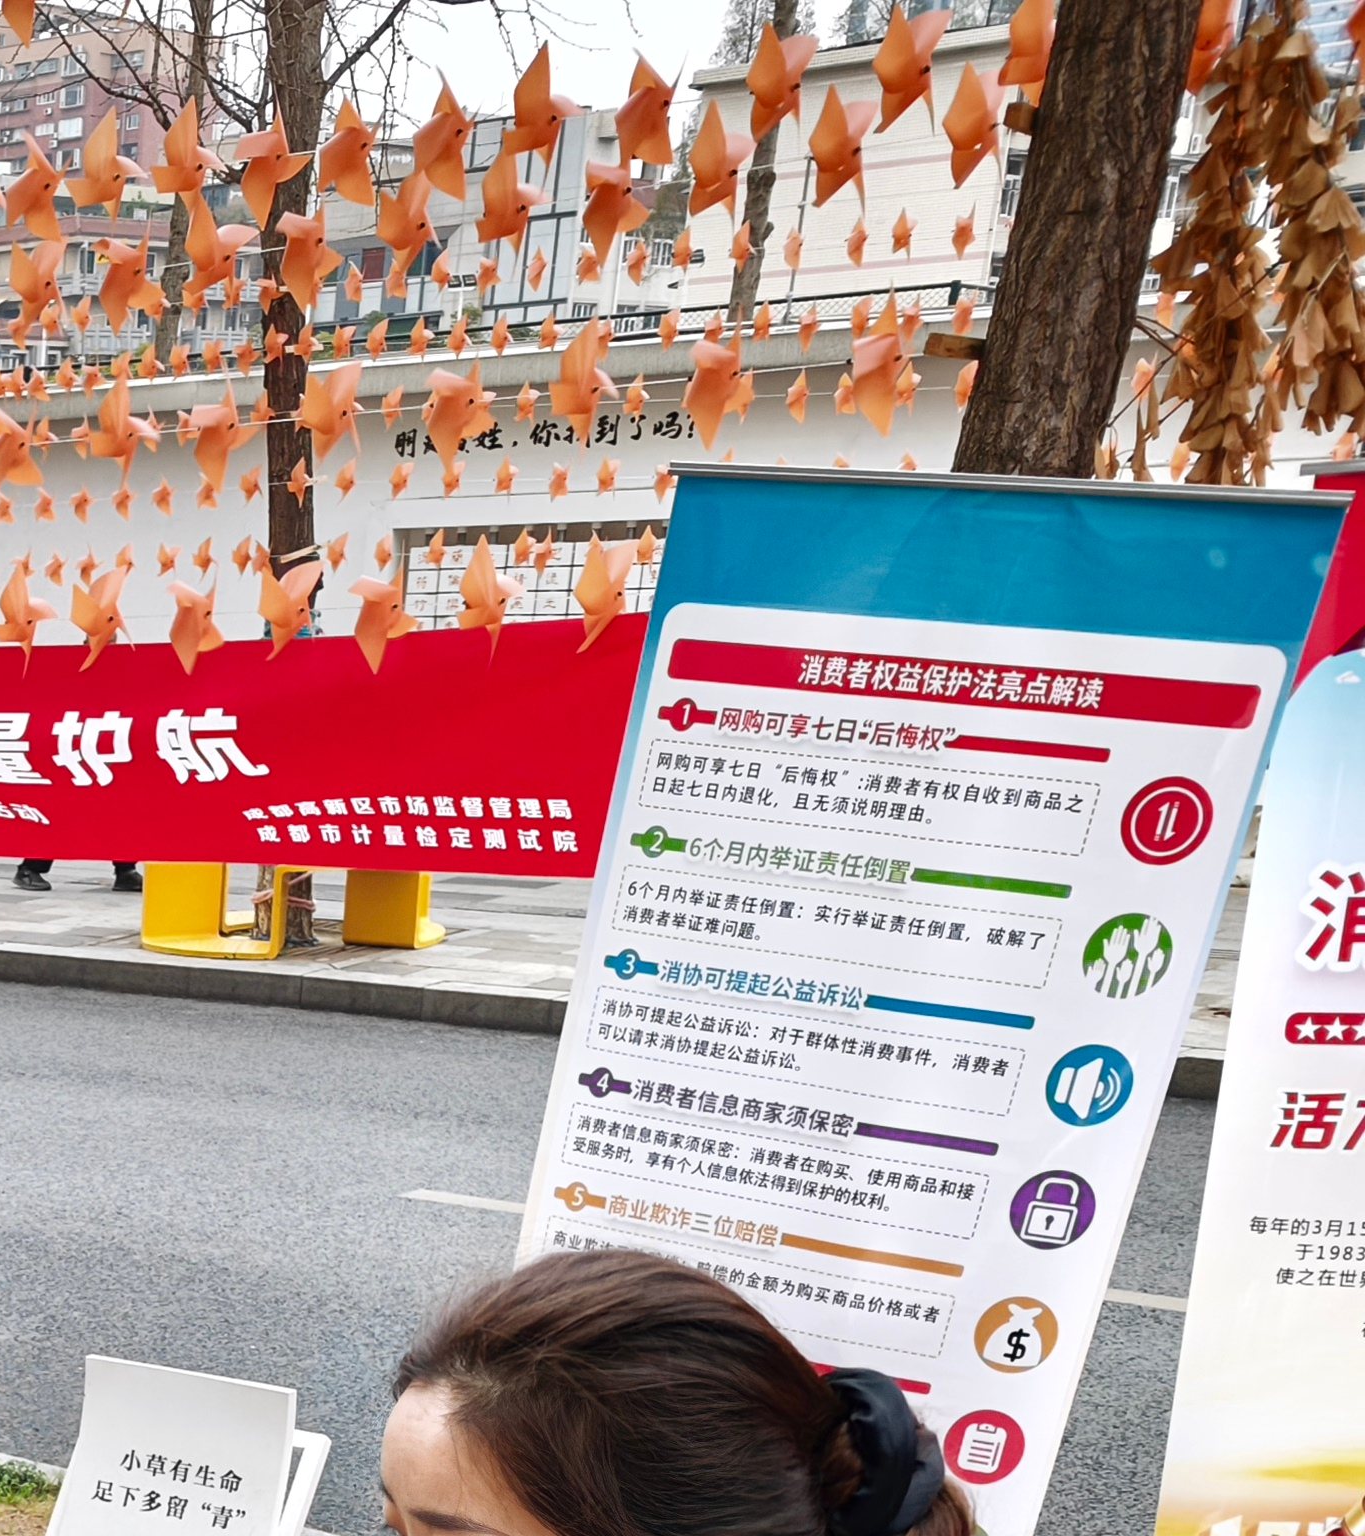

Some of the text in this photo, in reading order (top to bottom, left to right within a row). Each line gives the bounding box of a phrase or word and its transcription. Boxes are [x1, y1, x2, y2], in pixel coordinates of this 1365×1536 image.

[798, 654, 1104, 710] 消费者权益保护法亮点解读
[680, 705, 692, 726] 1
[718, 706, 957, 753] 网购可享七日“后悔权”
[242, 796, 573, 821] 成都高新区市场监督管理局
[652, 776, 934, 826] 日起七日内退化，且无须说明理由。
[257, 823, 579, 853] 成都市计量检定测试院
[649, 831, 663, 853] 2
[688, 836, 911, 886] 6个月内举证责任倒置
[622, 905, 762, 943] 消费者举证难问题。
[621, 953, 637, 974] 3
[659, 959, 867, 1011] 消协可提起公益诉讼
[597, 1022, 804, 1074] 可以请求消协提起公益诉讼。
[595, 1073, 609, 1093] 4
[633, 1078, 855, 1138] 消费者信息商家须保密
[570, 1187, 585, 1207] 5
[572, 1136, 893, 1213] 受服务时，享有个人信息依法得到保护的权利。
[607, 1194, 780, 1248] 商业欺诈三位赔偿
[1276, 1267, 1365, 1289] 使之在世
[120, 1449, 244, 1494] 小草有生命
[91, 1480, 246, 1531] 足下多留“青”
